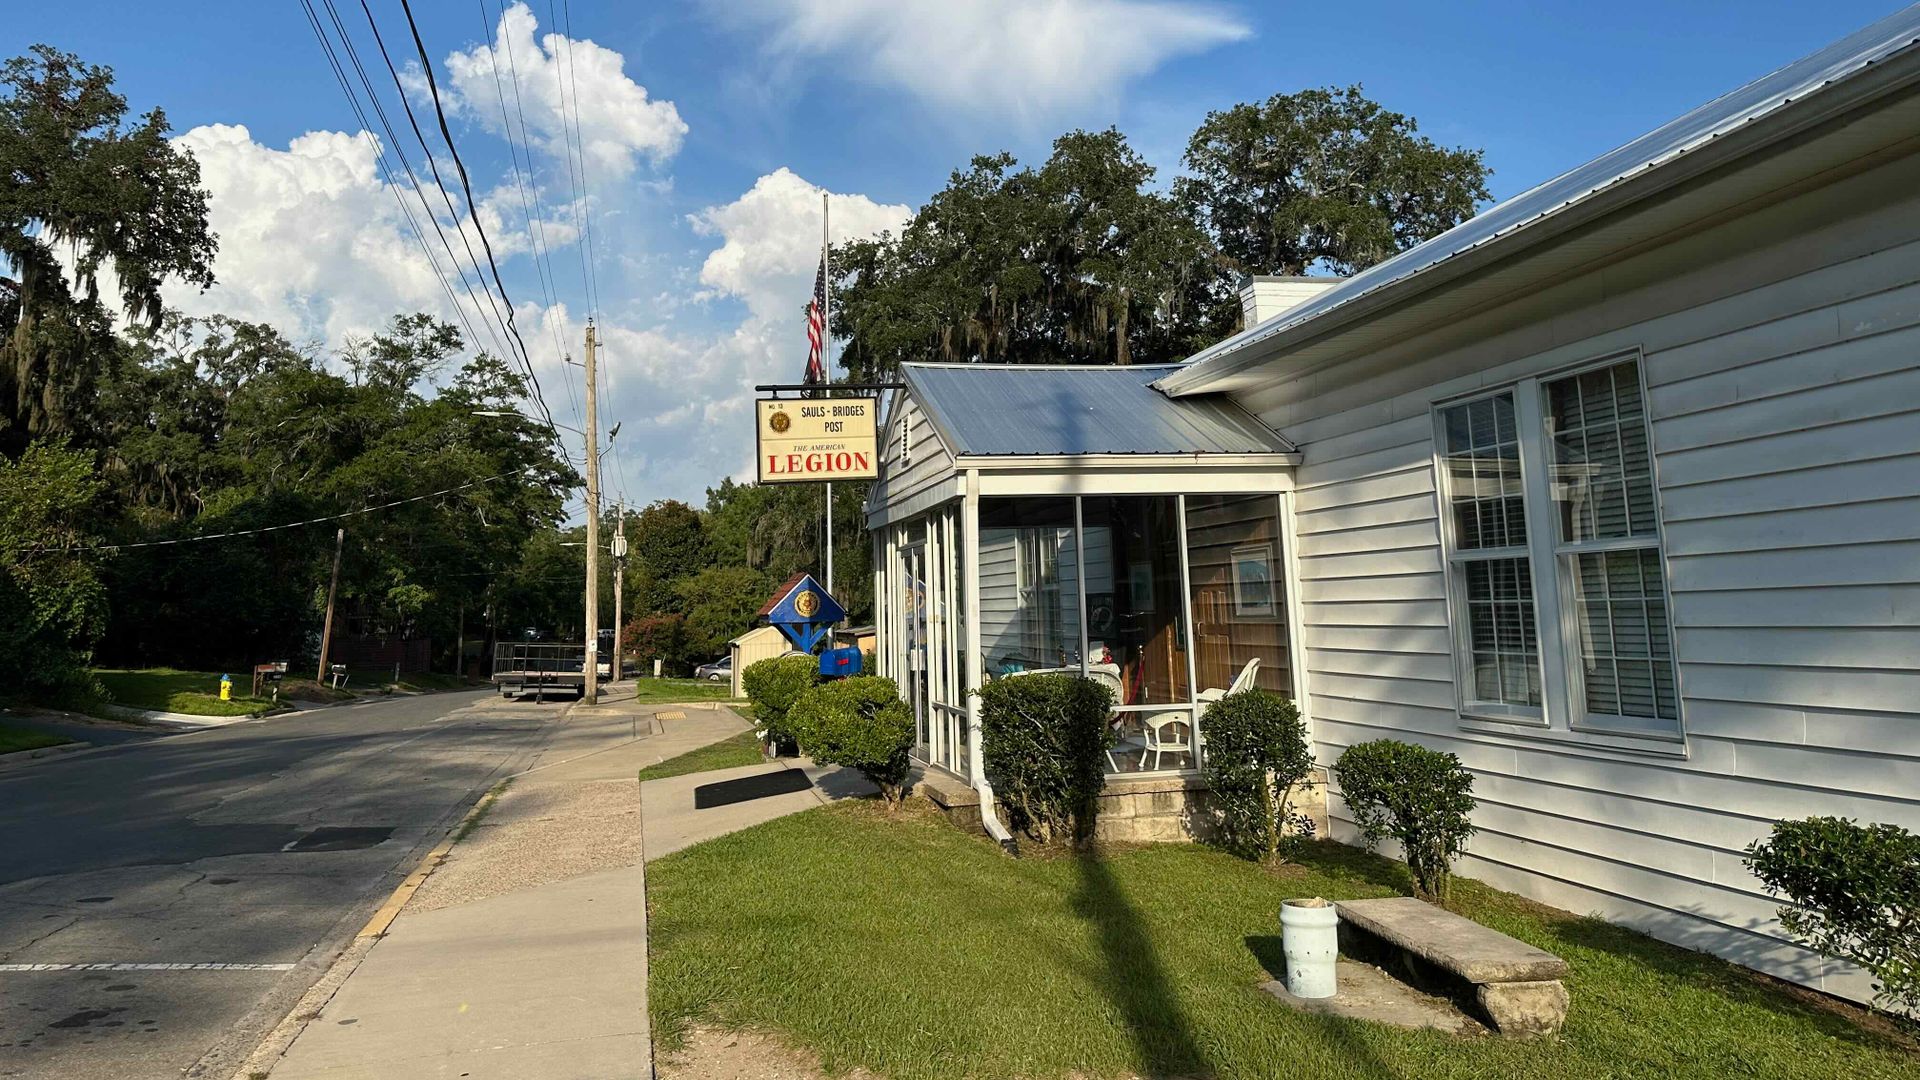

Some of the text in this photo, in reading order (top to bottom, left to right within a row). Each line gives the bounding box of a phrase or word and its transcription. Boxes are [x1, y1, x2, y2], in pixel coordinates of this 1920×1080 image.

[801, 406, 825, 417] SAULS
[833, 405, 864, 416] BRIDGES
[825, 421, 843, 432] POST
[809, 444, 846, 452] AMERICAN
[768, 452, 869, 474] LEGION
